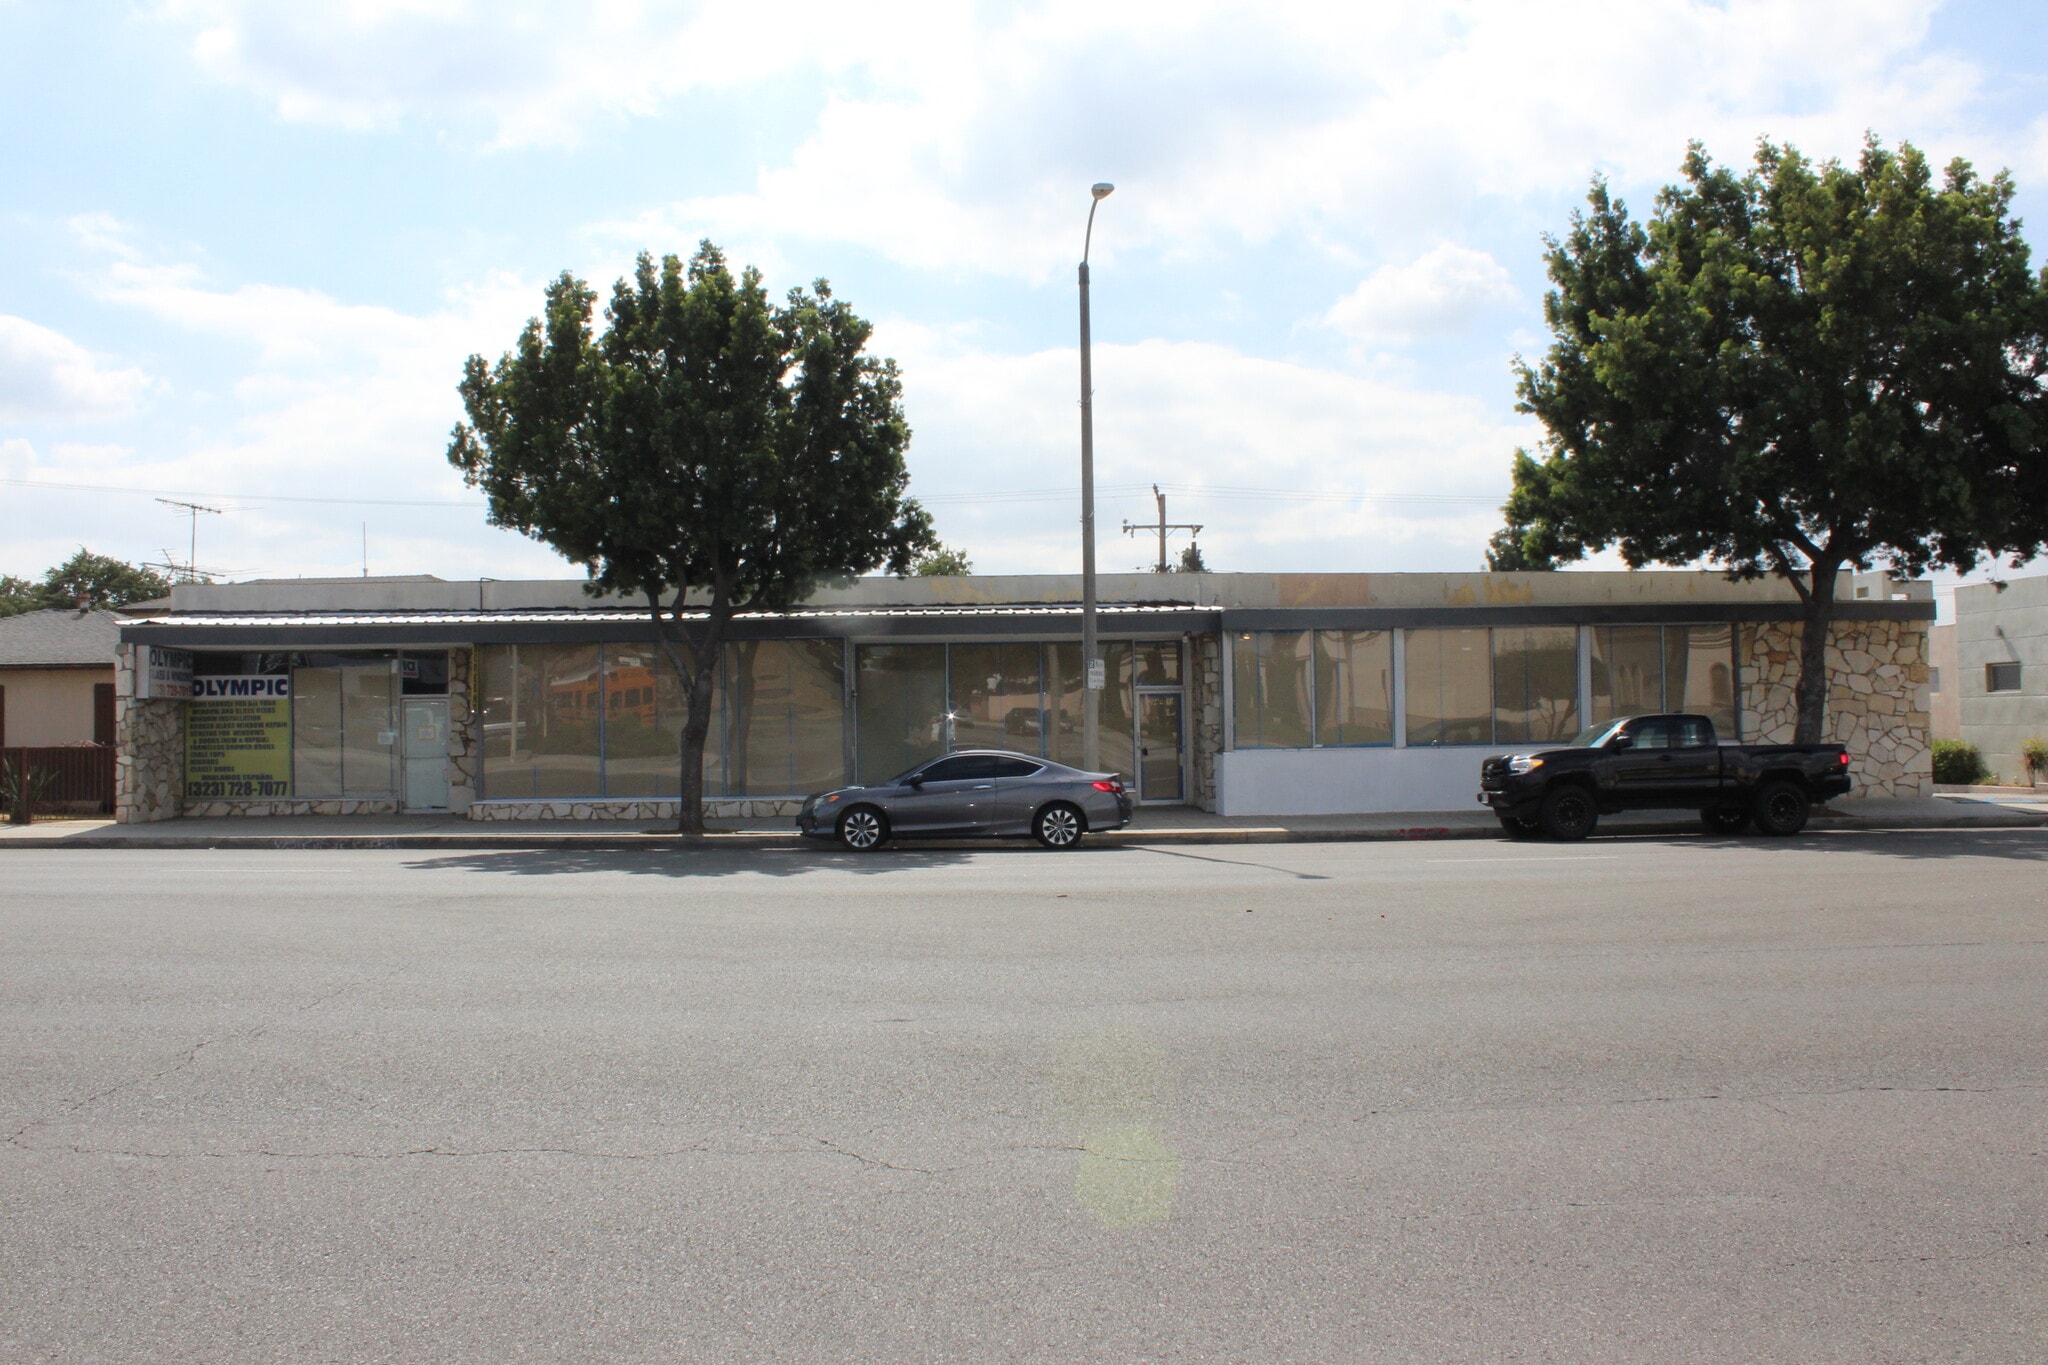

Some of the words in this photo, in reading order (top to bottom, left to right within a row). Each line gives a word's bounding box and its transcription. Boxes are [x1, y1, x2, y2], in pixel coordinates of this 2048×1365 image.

[150, 649, 192, 670] OLYMPIC
[193, 679, 288, 696] OLYMPIC
[188, 781, 225, 796] (323)
[227, 781, 288, 796] 728-7077
